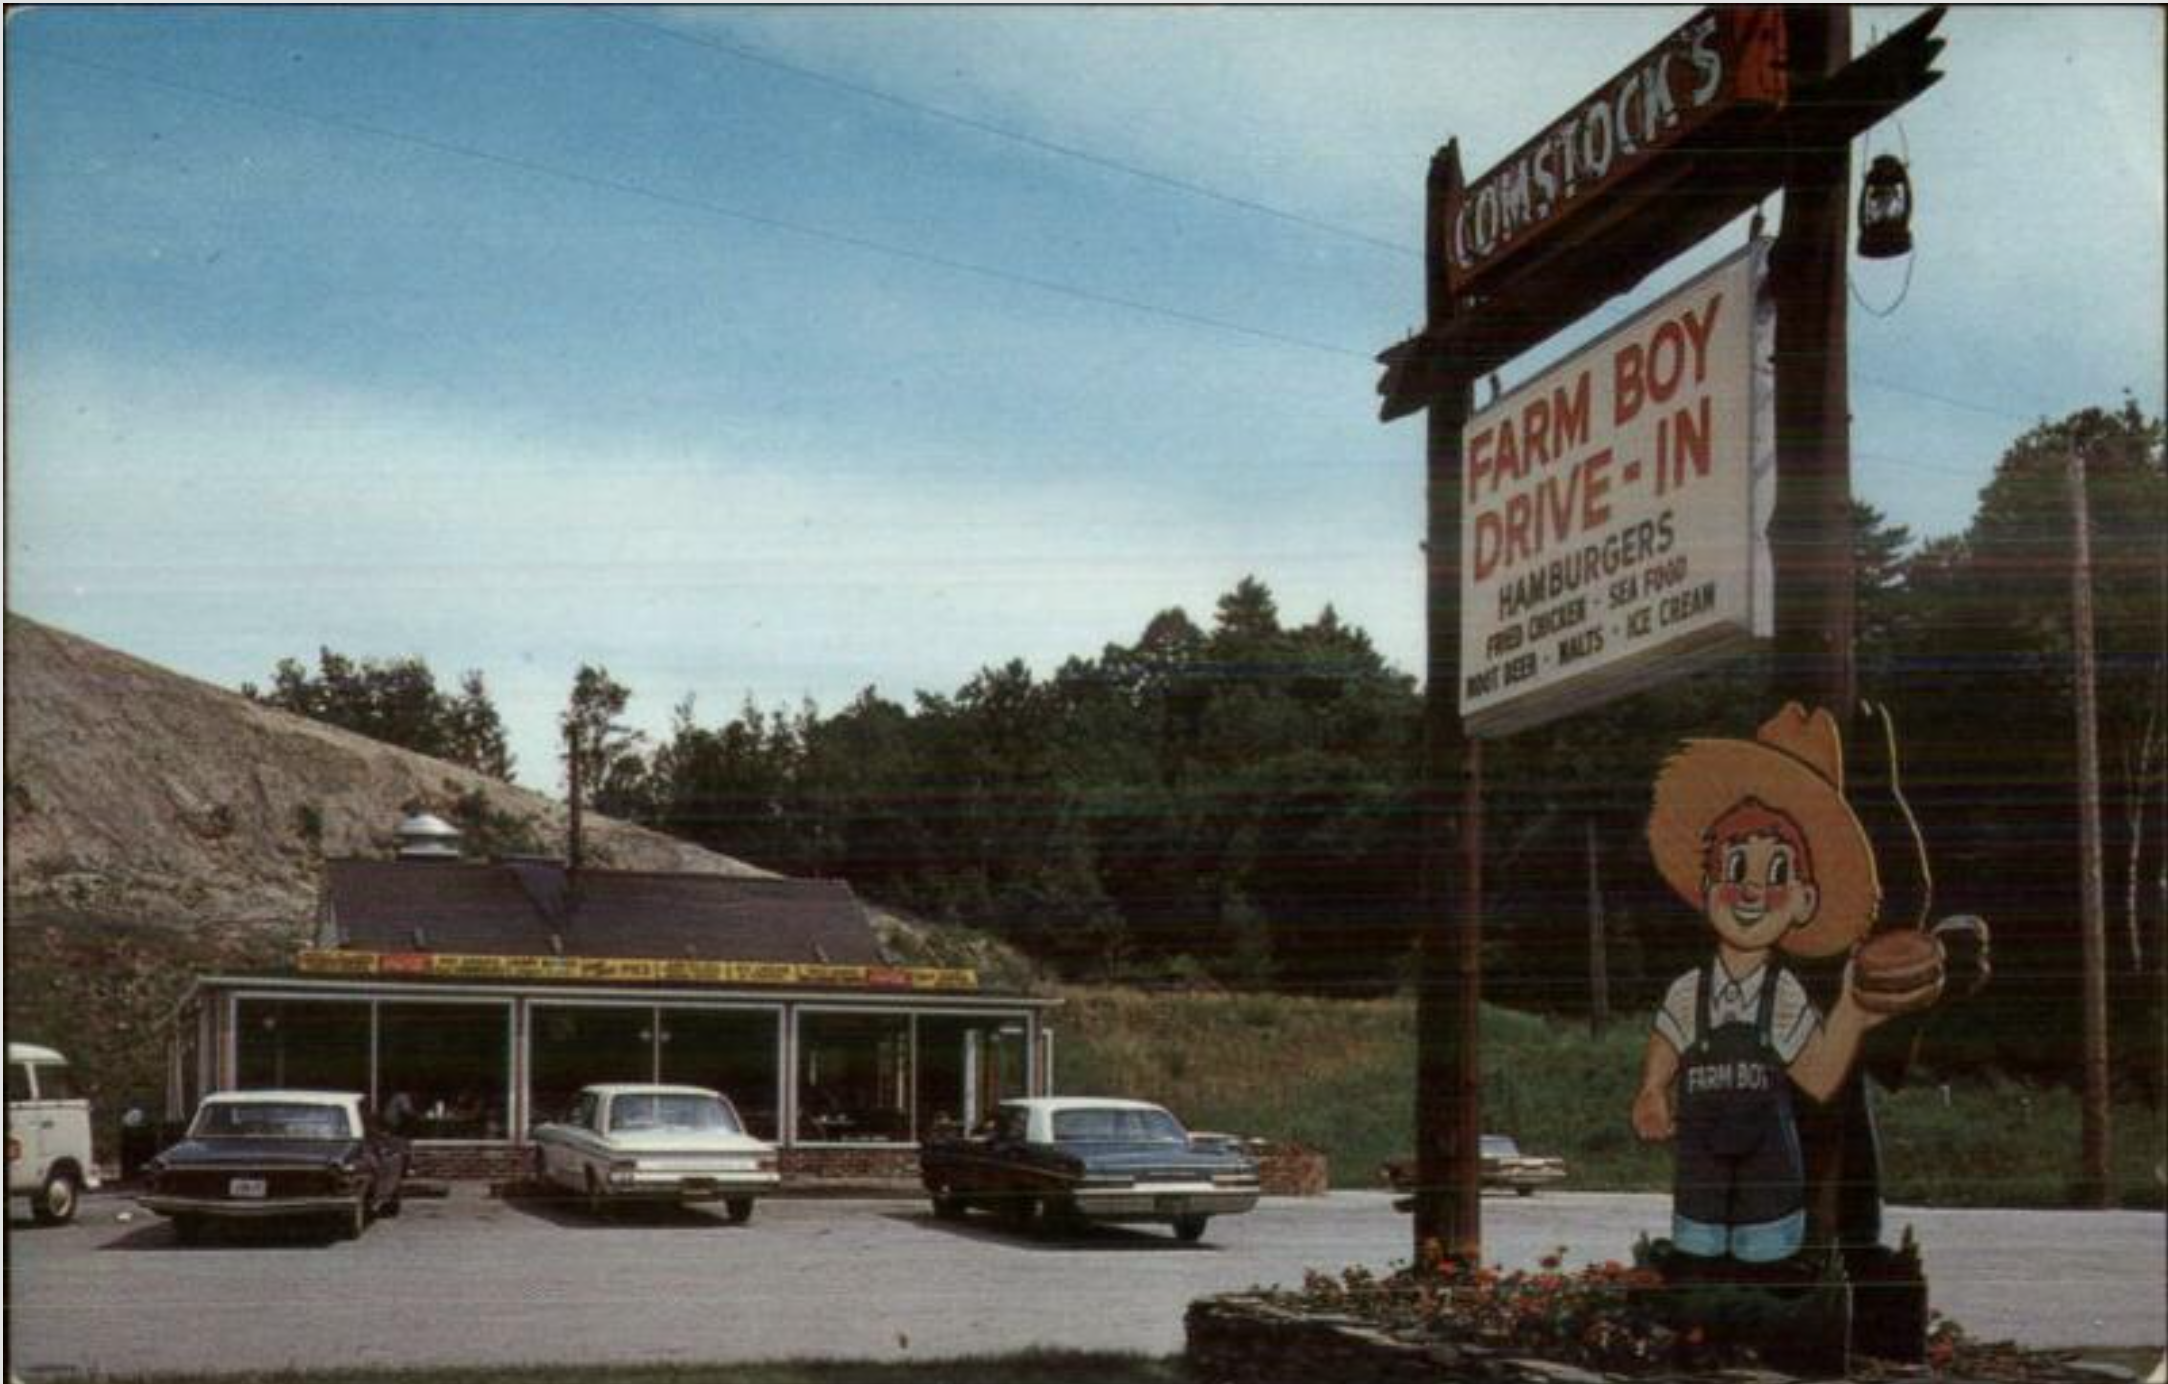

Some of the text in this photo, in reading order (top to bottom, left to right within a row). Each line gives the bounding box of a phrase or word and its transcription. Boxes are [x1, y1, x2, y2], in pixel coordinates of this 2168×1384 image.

[1454, 16, 1722, 268] COMSTOCK'S
[1469, 294, 1722, 504] FARM BOY
[1486, 555, 1688, 660] FRIED CHICKEN SEA FOOD
[1498, 509, 1674, 621] HAMBURGERS
[1558, 624, 1604, 666] MALTS
[1627, 605, 1652, 640] ICE
[1659, 580, 1716, 627] CREAM
[1687, 1063, 1732, 1095] FARM
